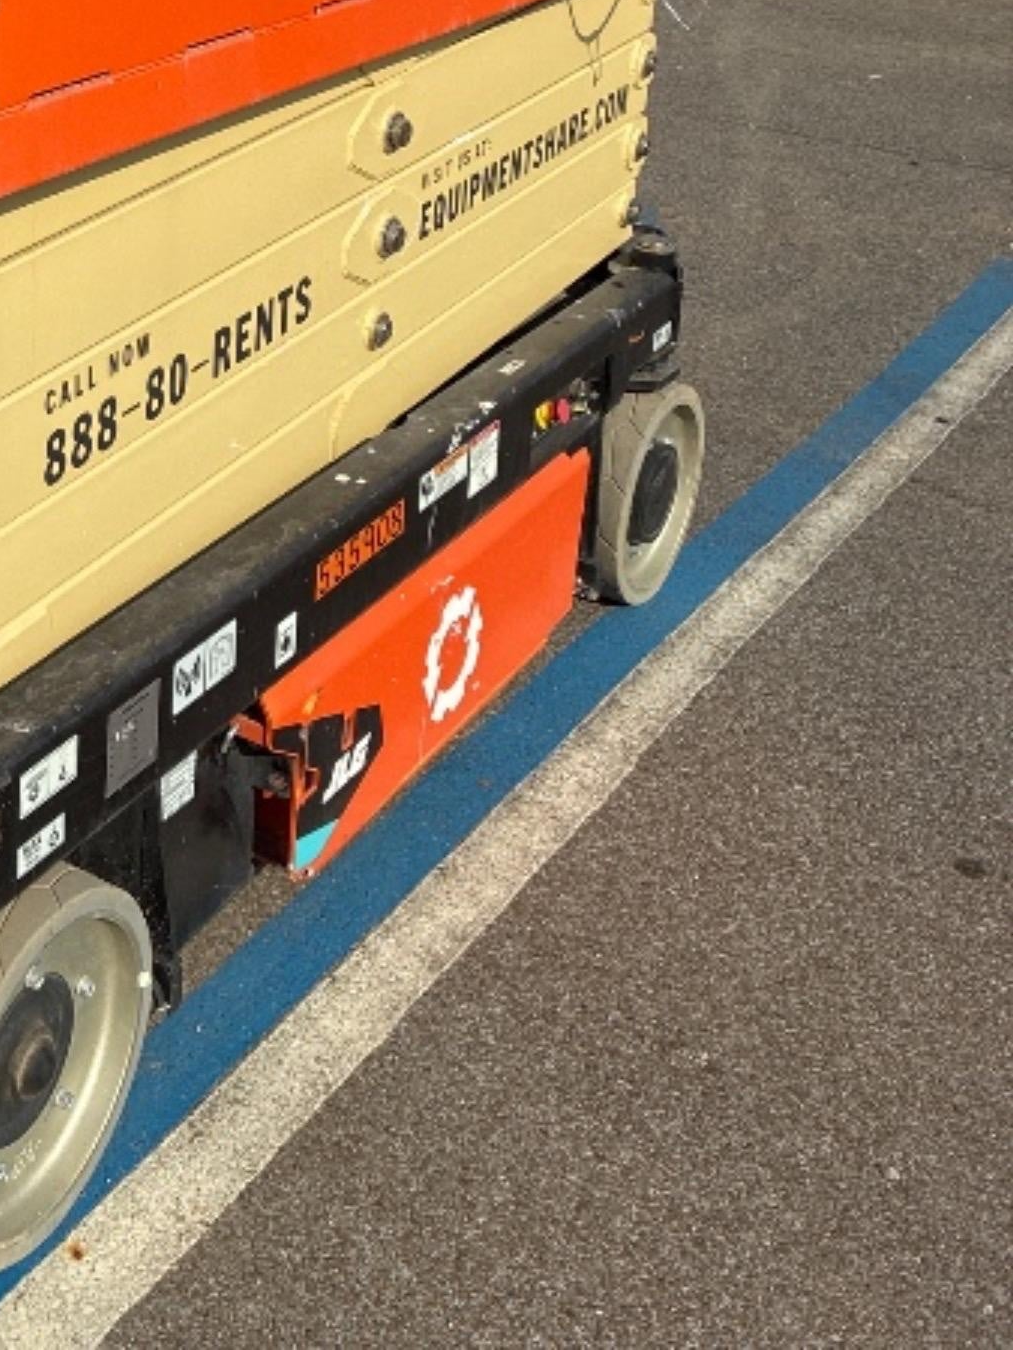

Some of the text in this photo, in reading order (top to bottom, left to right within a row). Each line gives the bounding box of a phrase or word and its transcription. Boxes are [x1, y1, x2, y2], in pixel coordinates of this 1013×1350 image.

[44, 332, 150, 415] CALL NOW
[44, 275, 312, 487] 888-80-RENTS
[321, 731, 373, 804] JLG
